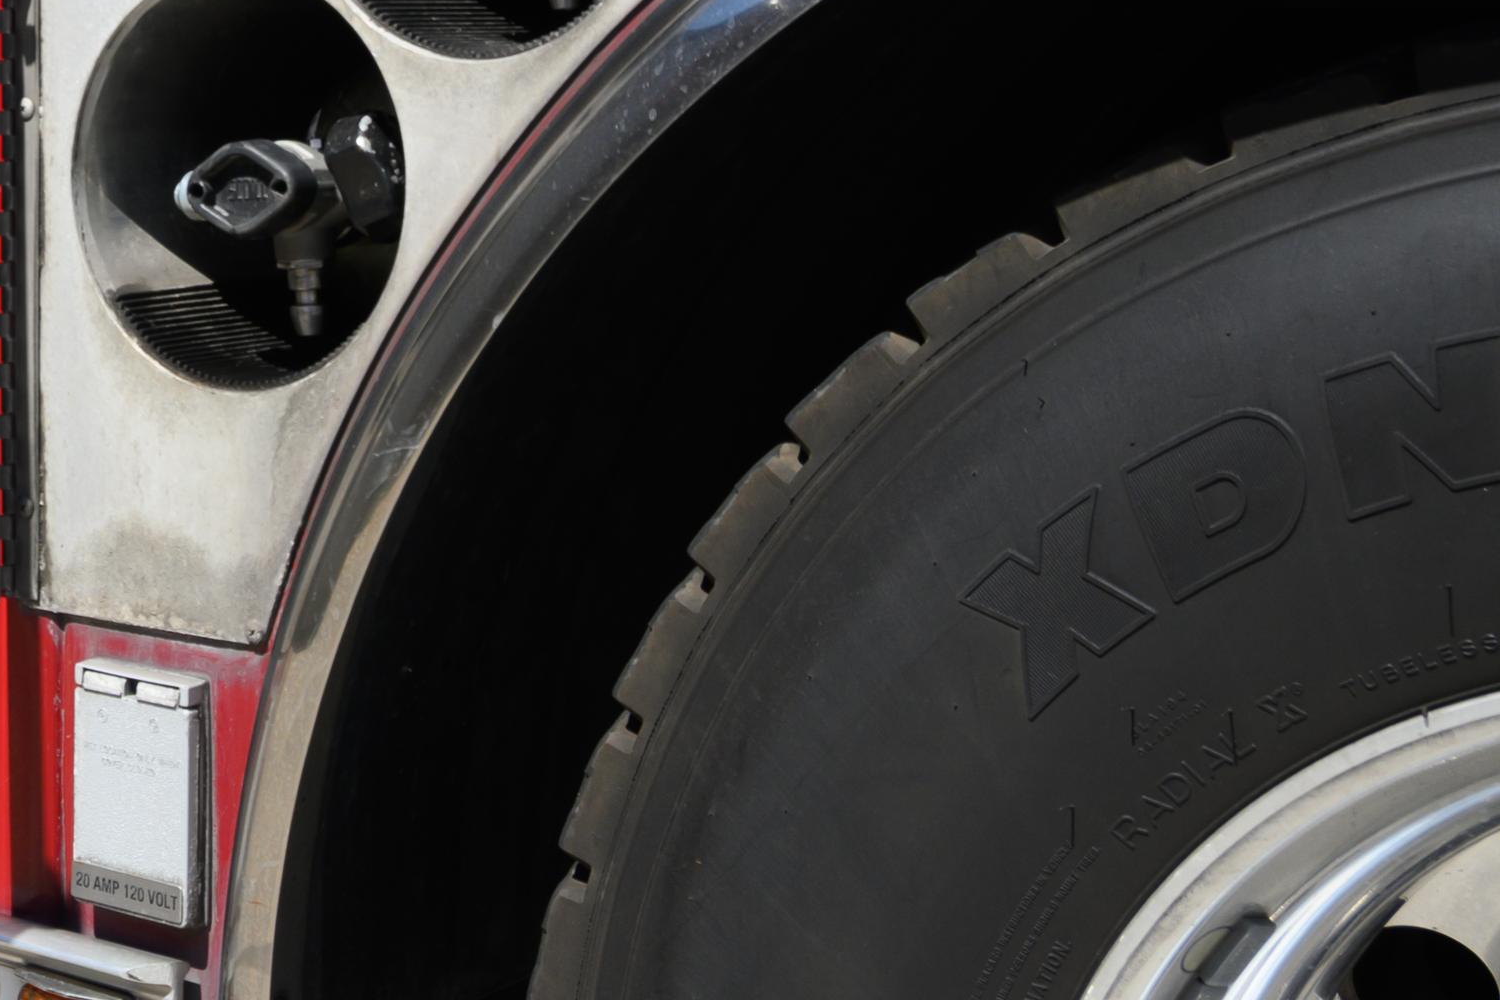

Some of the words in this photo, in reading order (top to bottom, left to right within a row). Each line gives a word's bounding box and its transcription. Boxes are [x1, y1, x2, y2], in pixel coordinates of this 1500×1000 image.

[1339, 633, 1499, 697] TUBELESS
[1111, 732, 1257, 850] RADIAL
[76, 871, 90, 888] 20
[93, 876, 119, 895] AMP
[124, 884, 144, 902] 120
[148, 888, 177, 910] VOLT
